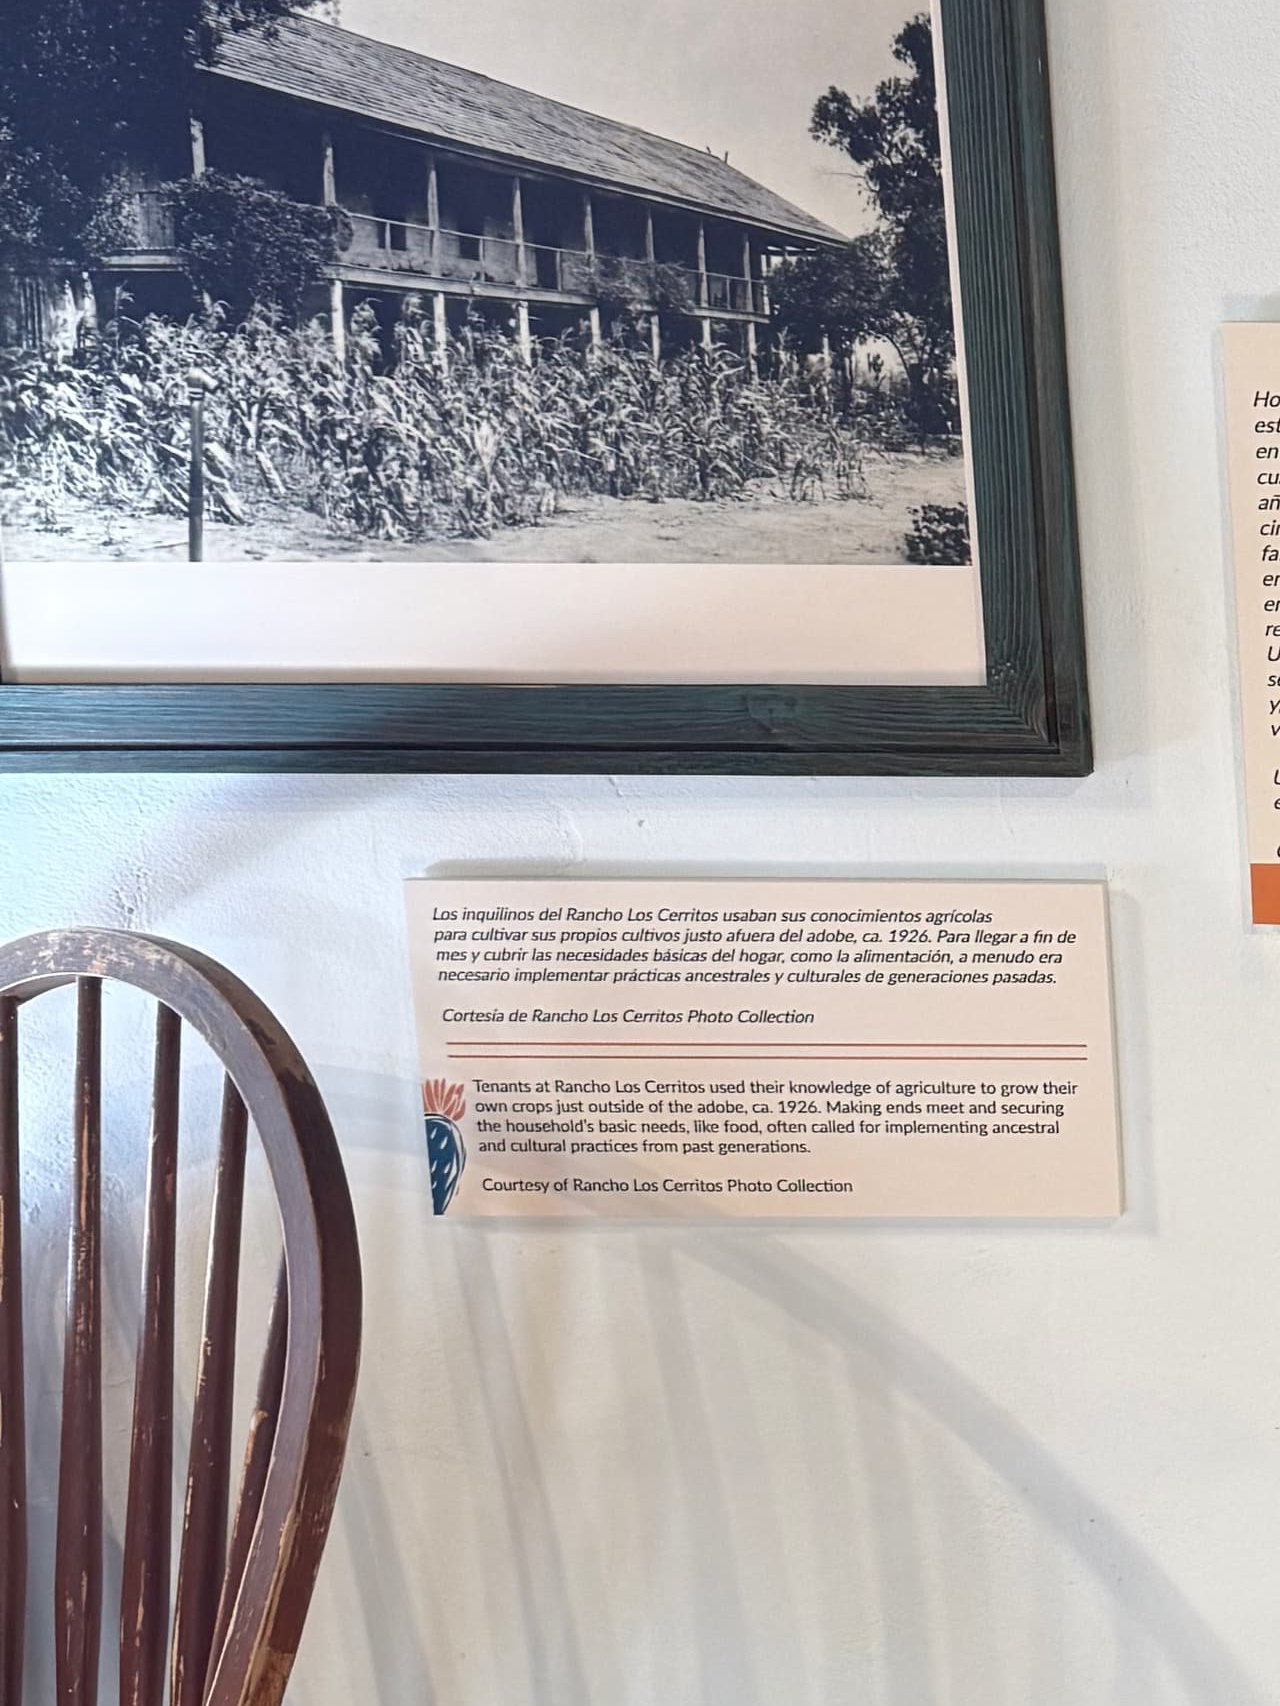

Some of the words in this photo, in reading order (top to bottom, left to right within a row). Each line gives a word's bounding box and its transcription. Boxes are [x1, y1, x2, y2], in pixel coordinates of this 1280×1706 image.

[432, 907, 458, 921] Los
[461, 906, 535, 924] inquilinos
[538, 907, 564, 922] del
[565, 907, 624, 922] Rancho
[627, 907, 654, 922] Los
[657, 907, 719, 923] Cerritos
[722, 908, 777, 923] usaban
[780, 911, 807, 923] sus
[809, 908, 923, 923] conocimientos
[925, 908, 993, 926] agrícolas
[442, 1008, 505, 1023] Cortesía
[508, 1008, 528, 1023] de
[531, 1008, 589, 1023] Rancho
[592, 1008, 619, 1023] Los
[622, 1008, 684, 1024] Cerritos
[687, 1009, 734, 1024] Photo
[737, 1009, 815, 1024] Collection
[471, 1079, 532, 1094] Tenants
[535, 1080, 552, 1094] at
[554, 1079, 612, 1094] Rancho
[615, 1079, 641, 1094] Los
[644, 1079, 706, 1094] Cerritos
[709, 1079, 746, 1094] used
[749, 1079, 786, 1094] their
[788, 1080, 872, 1098] knowledge
[875, 1080, 892, 1095] of
[895, 1080, 977, 1098] agriculture
[980, 1082, 997, 1095] to
[1000, 1084, 1039, 1098] grow
[1042, 1080, 1079, 1095] their
